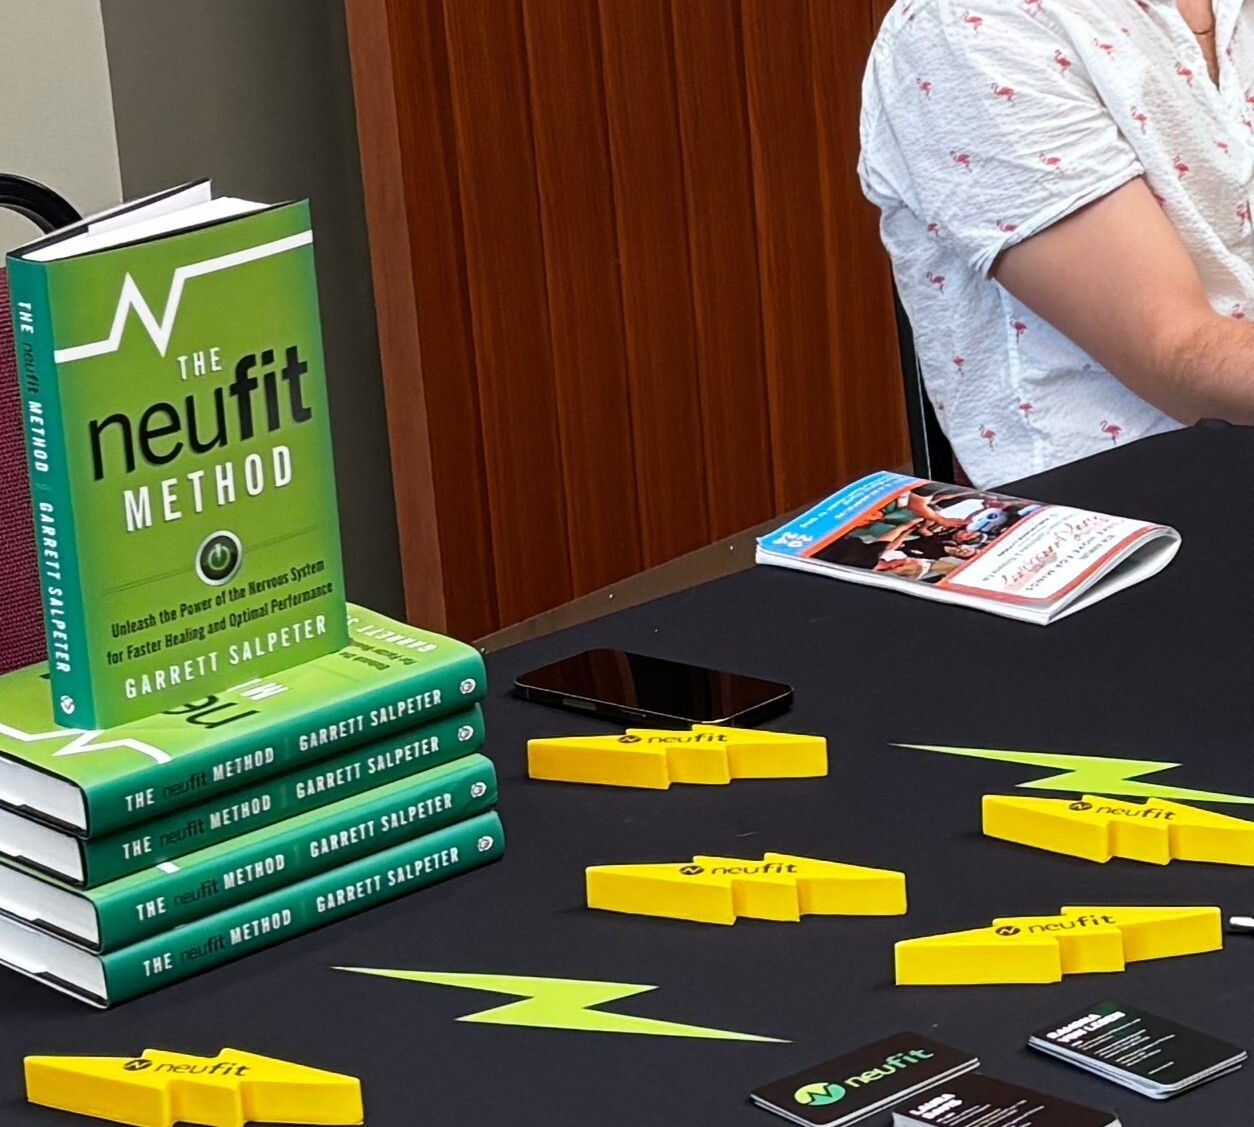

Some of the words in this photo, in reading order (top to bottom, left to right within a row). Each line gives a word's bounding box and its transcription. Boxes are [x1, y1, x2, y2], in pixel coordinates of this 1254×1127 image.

[18, 302, 34, 334] THE
[178, 348, 222, 380] THE
[28, 401, 49, 472] METHOD
[88, 345, 312, 480] neufit
[123, 445, 293, 532] METHOD
[39, 502, 61, 580] GARRETT
[48, 586, 71, 672] SALPETER
[107, 650, 124, 665] for
[127, 639, 162, 661] Faster
[165, 625, 206, 648] Healing
[208, 617, 227, 634] and
[229, 603, 268, 627] Optimal
[271, 582, 333, 613] Performance
[112, 614, 156, 638] Unleash
[159, 610, 177, 623] the
[180, 598, 212, 618] Power
[215, 591, 226, 605] of
[228, 589, 246, 602] the
[248, 573, 289, 595] Nervous
[291, 560, 325, 582] System
[125, 651, 218, 699] GARRETT
[229, 615, 326, 665] SALPETER
[125, 787, 155, 812] THE
[212, 747, 275, 783] METHOD
[299, 715, 364, 752] GARRETT
[370, 689, 442, 726] SALPETER
[647, 732, 728, 745] neufit
[122, 836, 152, 860] THE
[209, 795, 272, 830] METHOD
[296, 764, 361, 800] GARRETT
[367, 736, 440, 775] SALPETER
[1095, 806, 1176, 821] neufit
[136, 896, 166, 922] THE
[223, 854, 285, 891] METHOD
[310, 824, 375, 858] GARRETT
[381, 792, 453, 832] SALPETER
[711, 863, 798, 876] neufit
[143, 952, 173, 977] THE
[229, 909, 292, 945] METHOD
[316, 877, 381, 914] GARRETT
[387, 847, 460, 887] SALPETER
[1028, 915, 1117, 934] neufit
[154, 1061, 250, 1077] neufit
[845, 1049, 934, 1088] neufit
